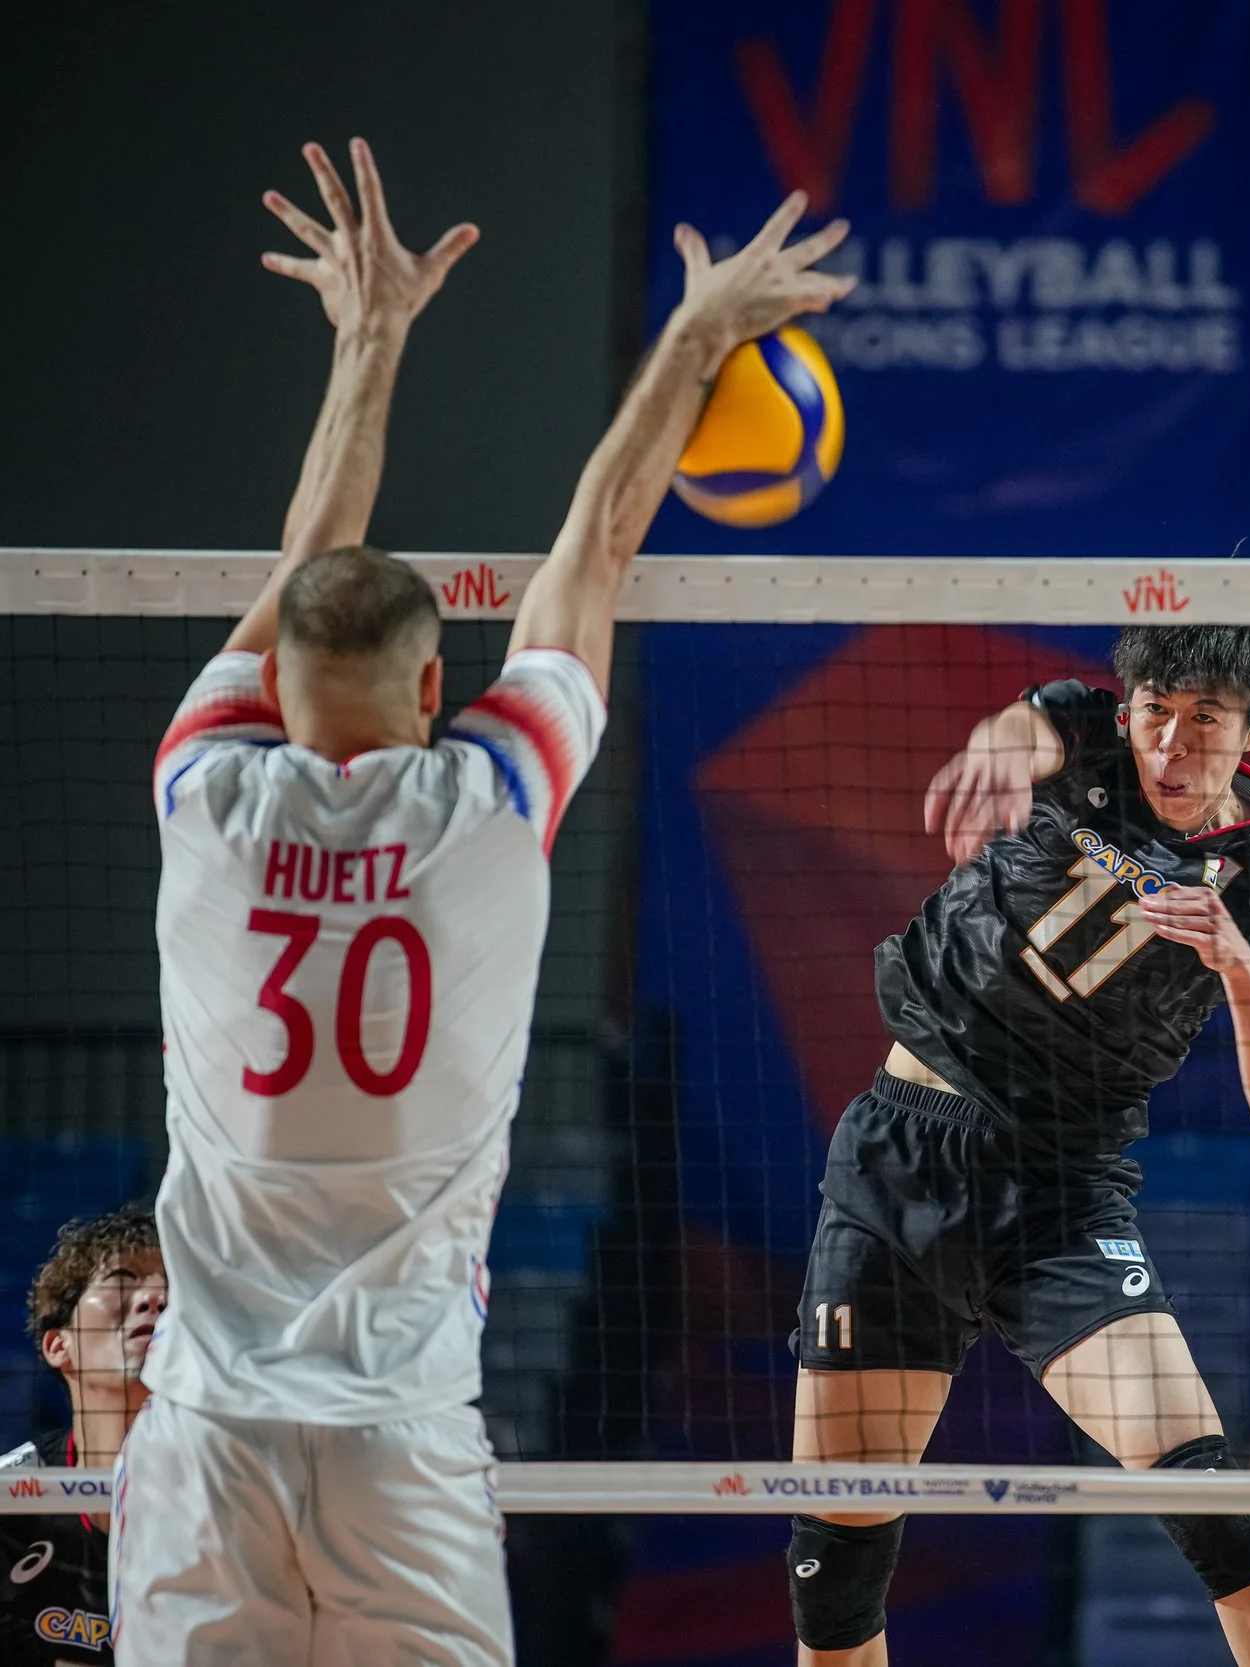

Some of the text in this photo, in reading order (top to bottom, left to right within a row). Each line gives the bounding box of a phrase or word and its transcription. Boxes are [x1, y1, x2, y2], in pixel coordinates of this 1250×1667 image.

[735, 0, 1210, 213] VNL
[715, 237, 1238, 308] LLEYBALL
[1000, 313, 1241, 371] LEAGUE
[441, 563, 511, 609] VNL
[1123, 569, 1190, 614] VNL
[264, 840, 411, 902] HUETZ
[242, 908, 433, 1098] 30
[1100, 1241, 1142, 1257] TEL
[815, 1303, 851, 1349] 11
[8, 1476, 49, 1498] VNL
[713, 1472, 918, 1496] VNL VOLLEYBALL
